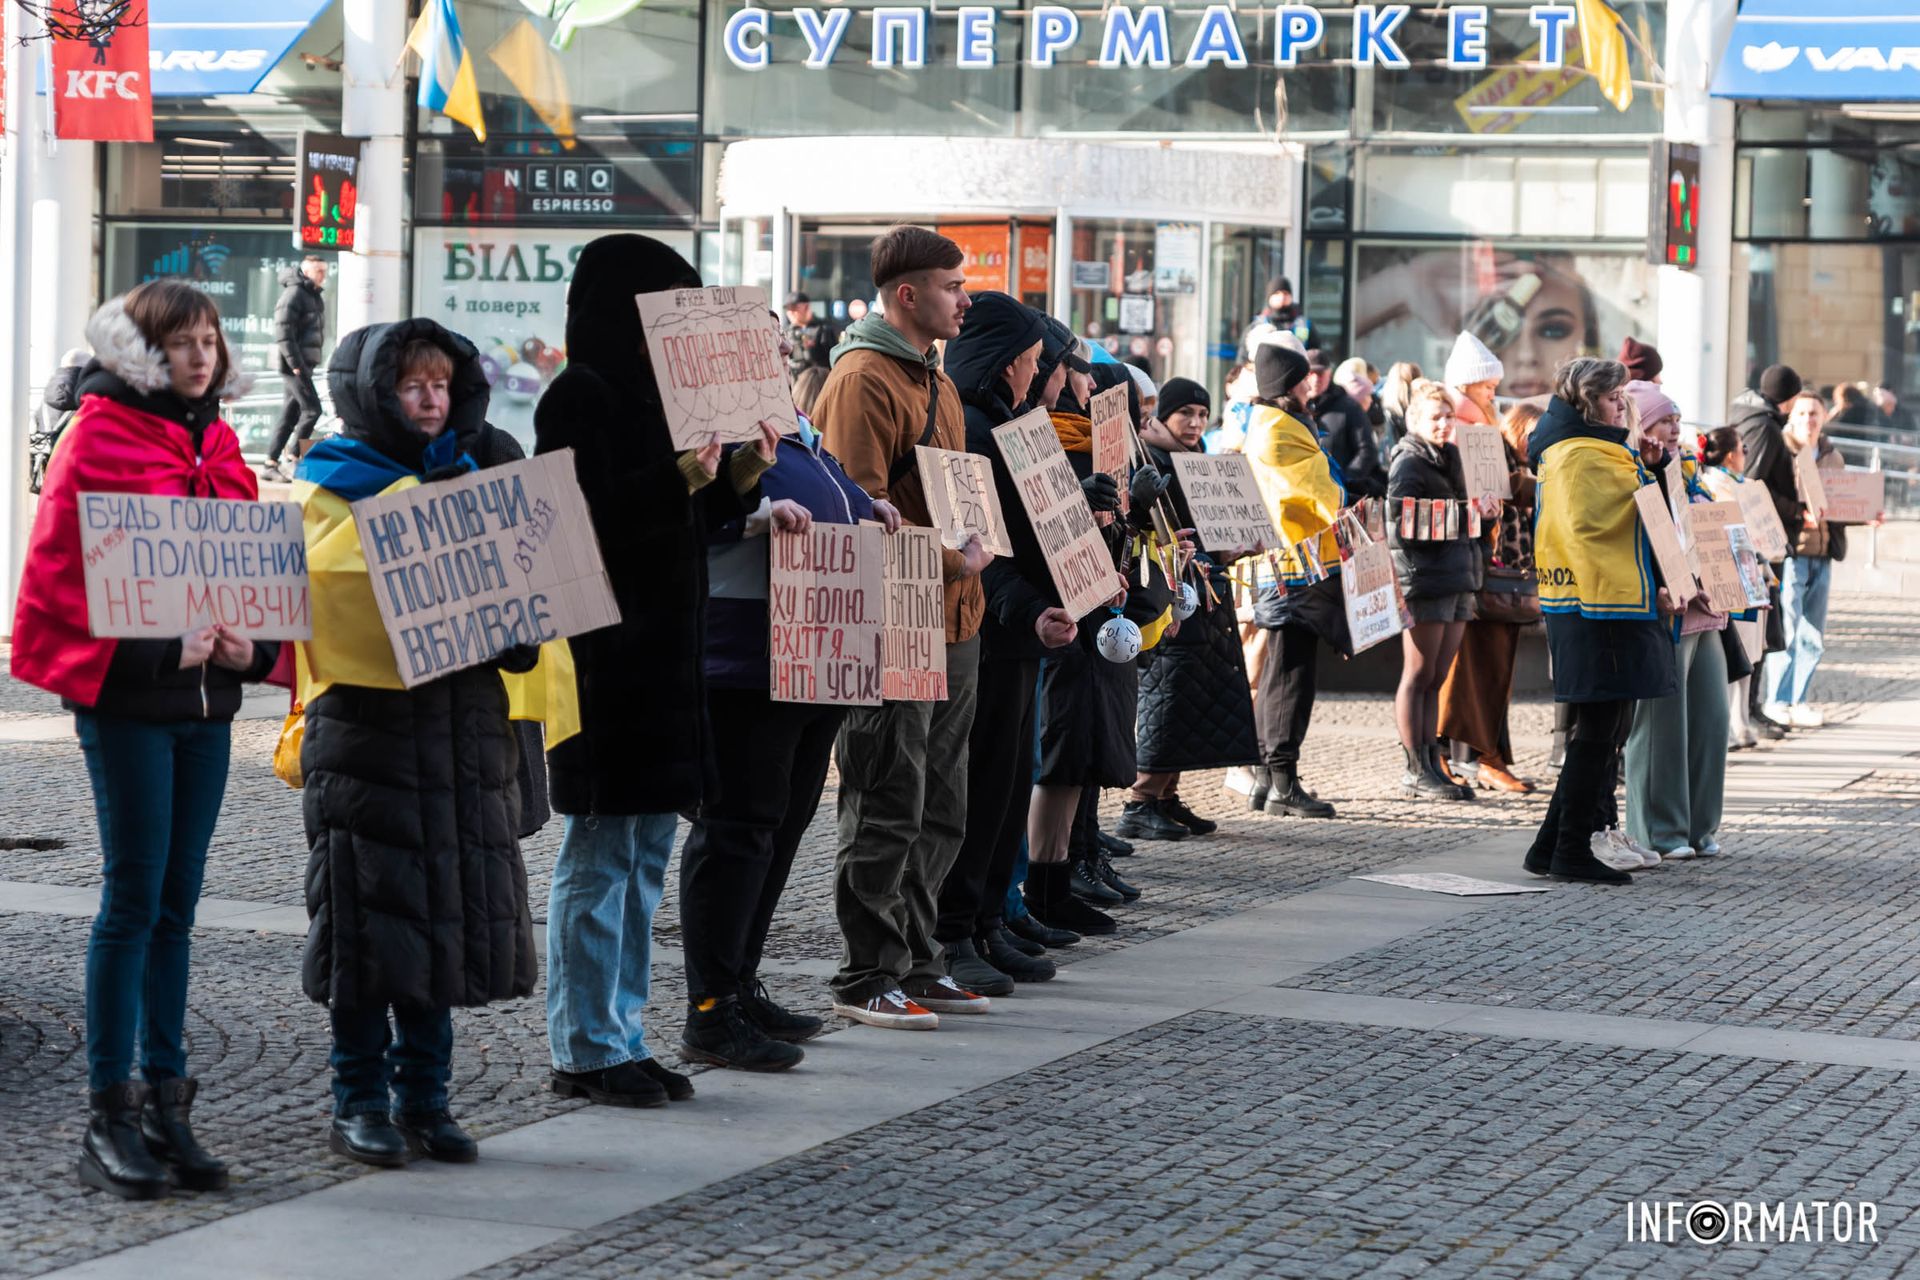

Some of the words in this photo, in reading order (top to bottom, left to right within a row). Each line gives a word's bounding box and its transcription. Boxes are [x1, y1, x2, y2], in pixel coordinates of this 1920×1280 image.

[724, 5, 1576, 70] СУПЕРМАРКЕТ
[64, 70, 139, 99] KFC
[503, 169, 609, 189] NERO
[532, 199, 614, 211] ESPRESSO
[445, 296, 458, 312] 4
[465, 299, 541, 317] поверх
[86, 496, 160, 531] БУДЬ
[171, 499, 286, 534] ГОЛОСОМ
[411, 474, 532, 553] МОВЧИ
[133, 537, 308, 578] ПОЛОНЕНИХ
[383, 541, 510, 618] ПОЛОН
[105, 578, 158, 626] НЕ
[186, 582, 309, 629] МОВЧИ
